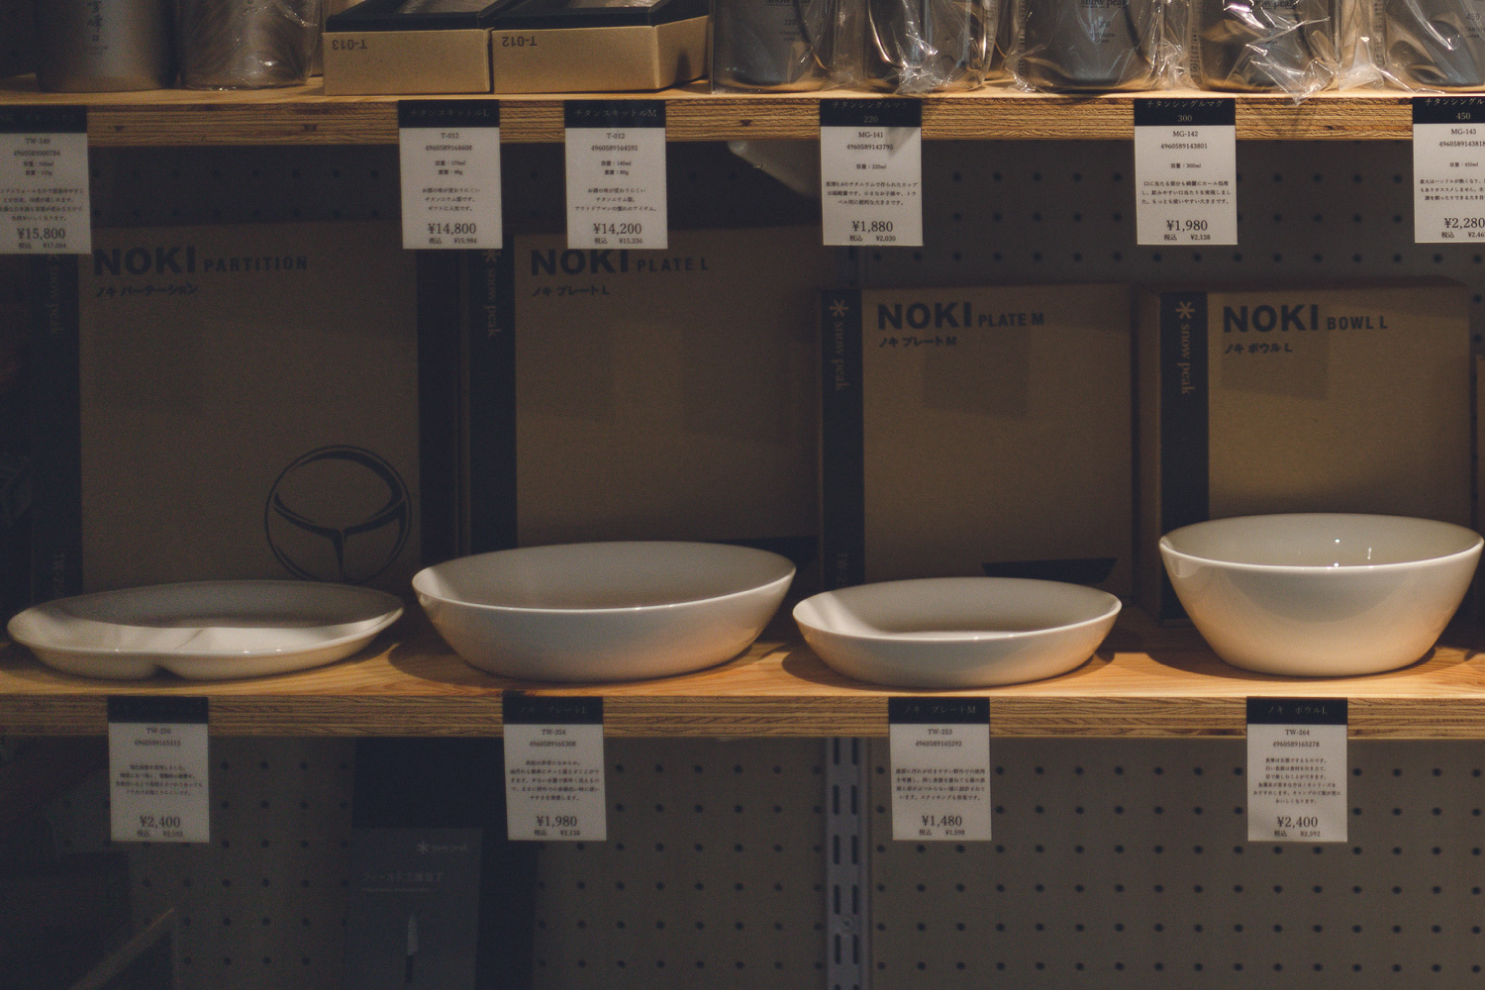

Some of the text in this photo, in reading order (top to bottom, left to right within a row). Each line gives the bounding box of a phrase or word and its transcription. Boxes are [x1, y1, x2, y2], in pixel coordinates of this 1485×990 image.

[863, 115, 879, 123] 220
[1177, 114, 1193, 123] 300
[1455, 112, 1471, 120] 450
[857, 130, 885, 139] MG-141
[1172, 129, 1199, 138] MG-142
[1450, 127, 1477, 136] MG-143
[1160, 141, 1209, 151] 4960589143801
[426, 221, 478, 236] ¥14,800
[592, 221, 644, 237] ¥14,200
[851, 219, 895, 234] ¥1,880
[1165, 218, 1209, 234] ¥1,980
[15, 226, 67, 242] ¥15,800
[93, 246, 308, 277] NOKI PARTITION
[530, 248, 710, 276] NOKI PLATE L
[876, 302, 1045, 331] NOKI PLATE M
[1223, 304, 1389, 333] NOKI BOWL L
[877, 336, 899, 348] ノキ
[1223, 342, 1246, 355] ノキ
[1176, 323, 1197, 395] snow peak
[1283, 727, 1311, 737] TW-264
[138, 816, 182, 832] ¥2,400
[534, 814, 579, 829] ¥1,980
[920, 814, 964, 829] ¥1,480
[1275, 815, 1319, 830] ¥2,400
